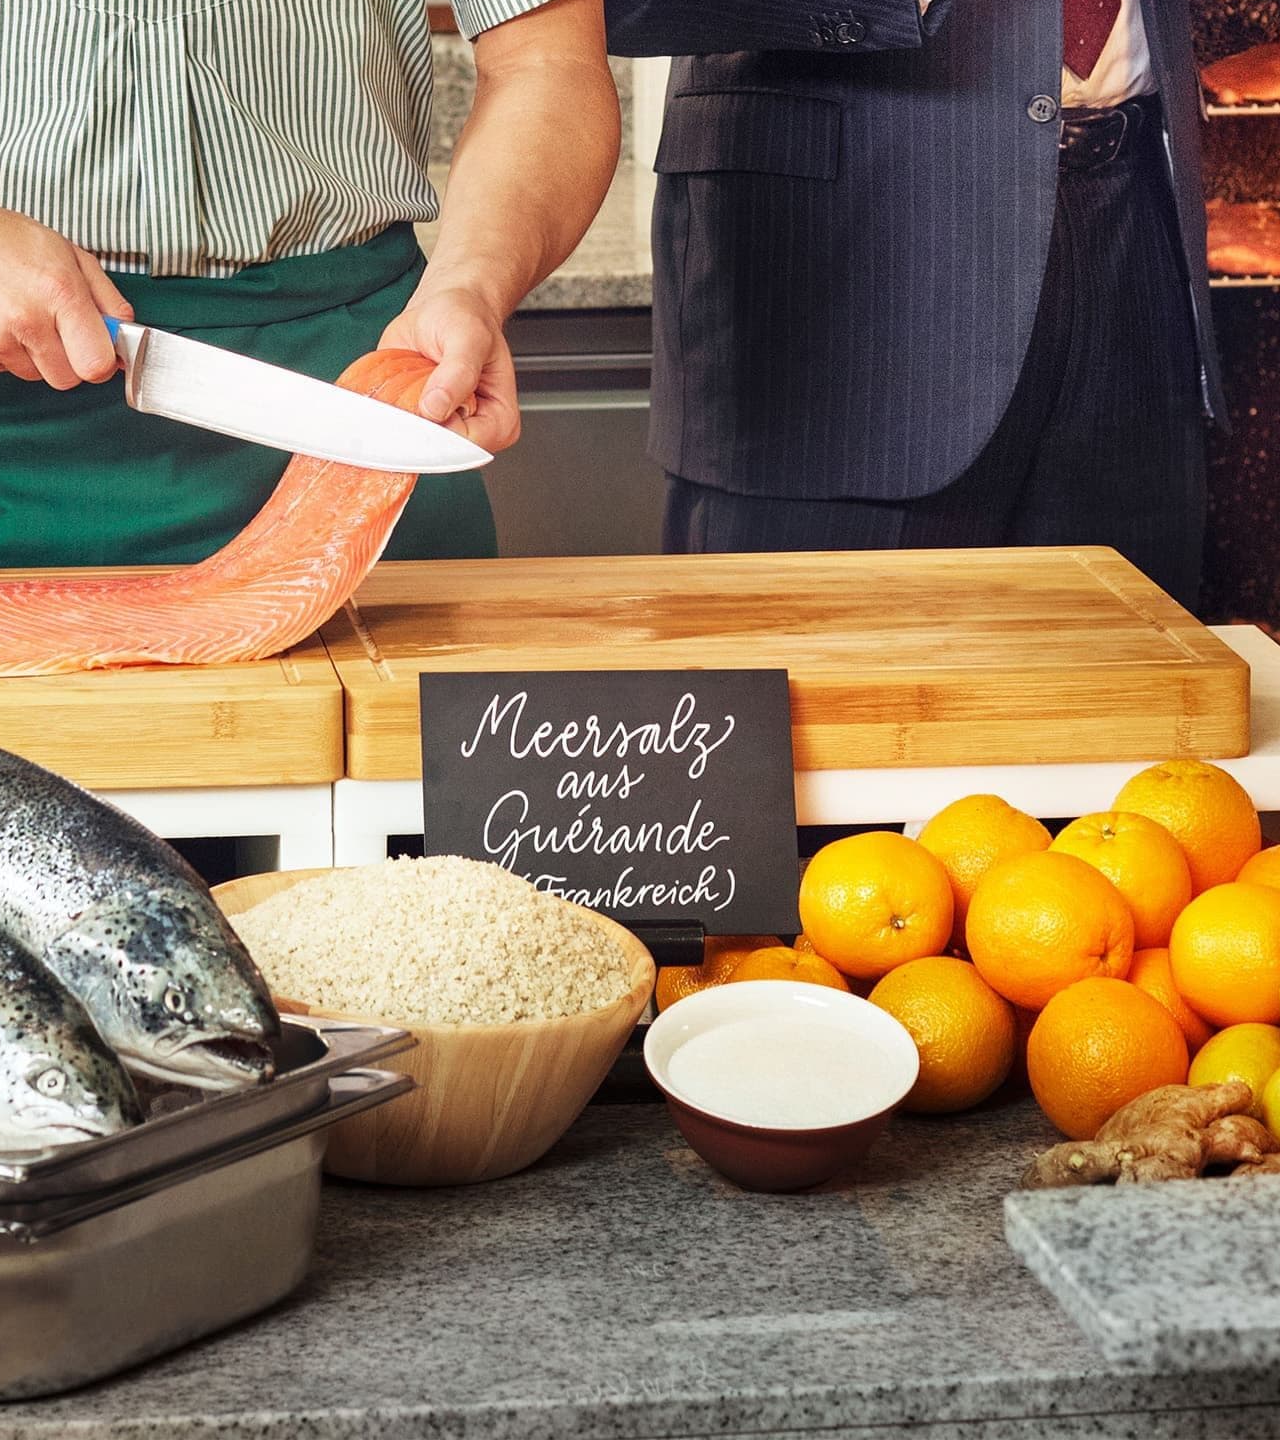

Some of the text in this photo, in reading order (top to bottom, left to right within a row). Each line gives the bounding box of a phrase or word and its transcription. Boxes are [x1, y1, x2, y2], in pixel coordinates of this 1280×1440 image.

[460, 691, 735, 779] Meersalz
[556, 764, 645, 800] aus
[483, 789, 731, 872] Guérande
